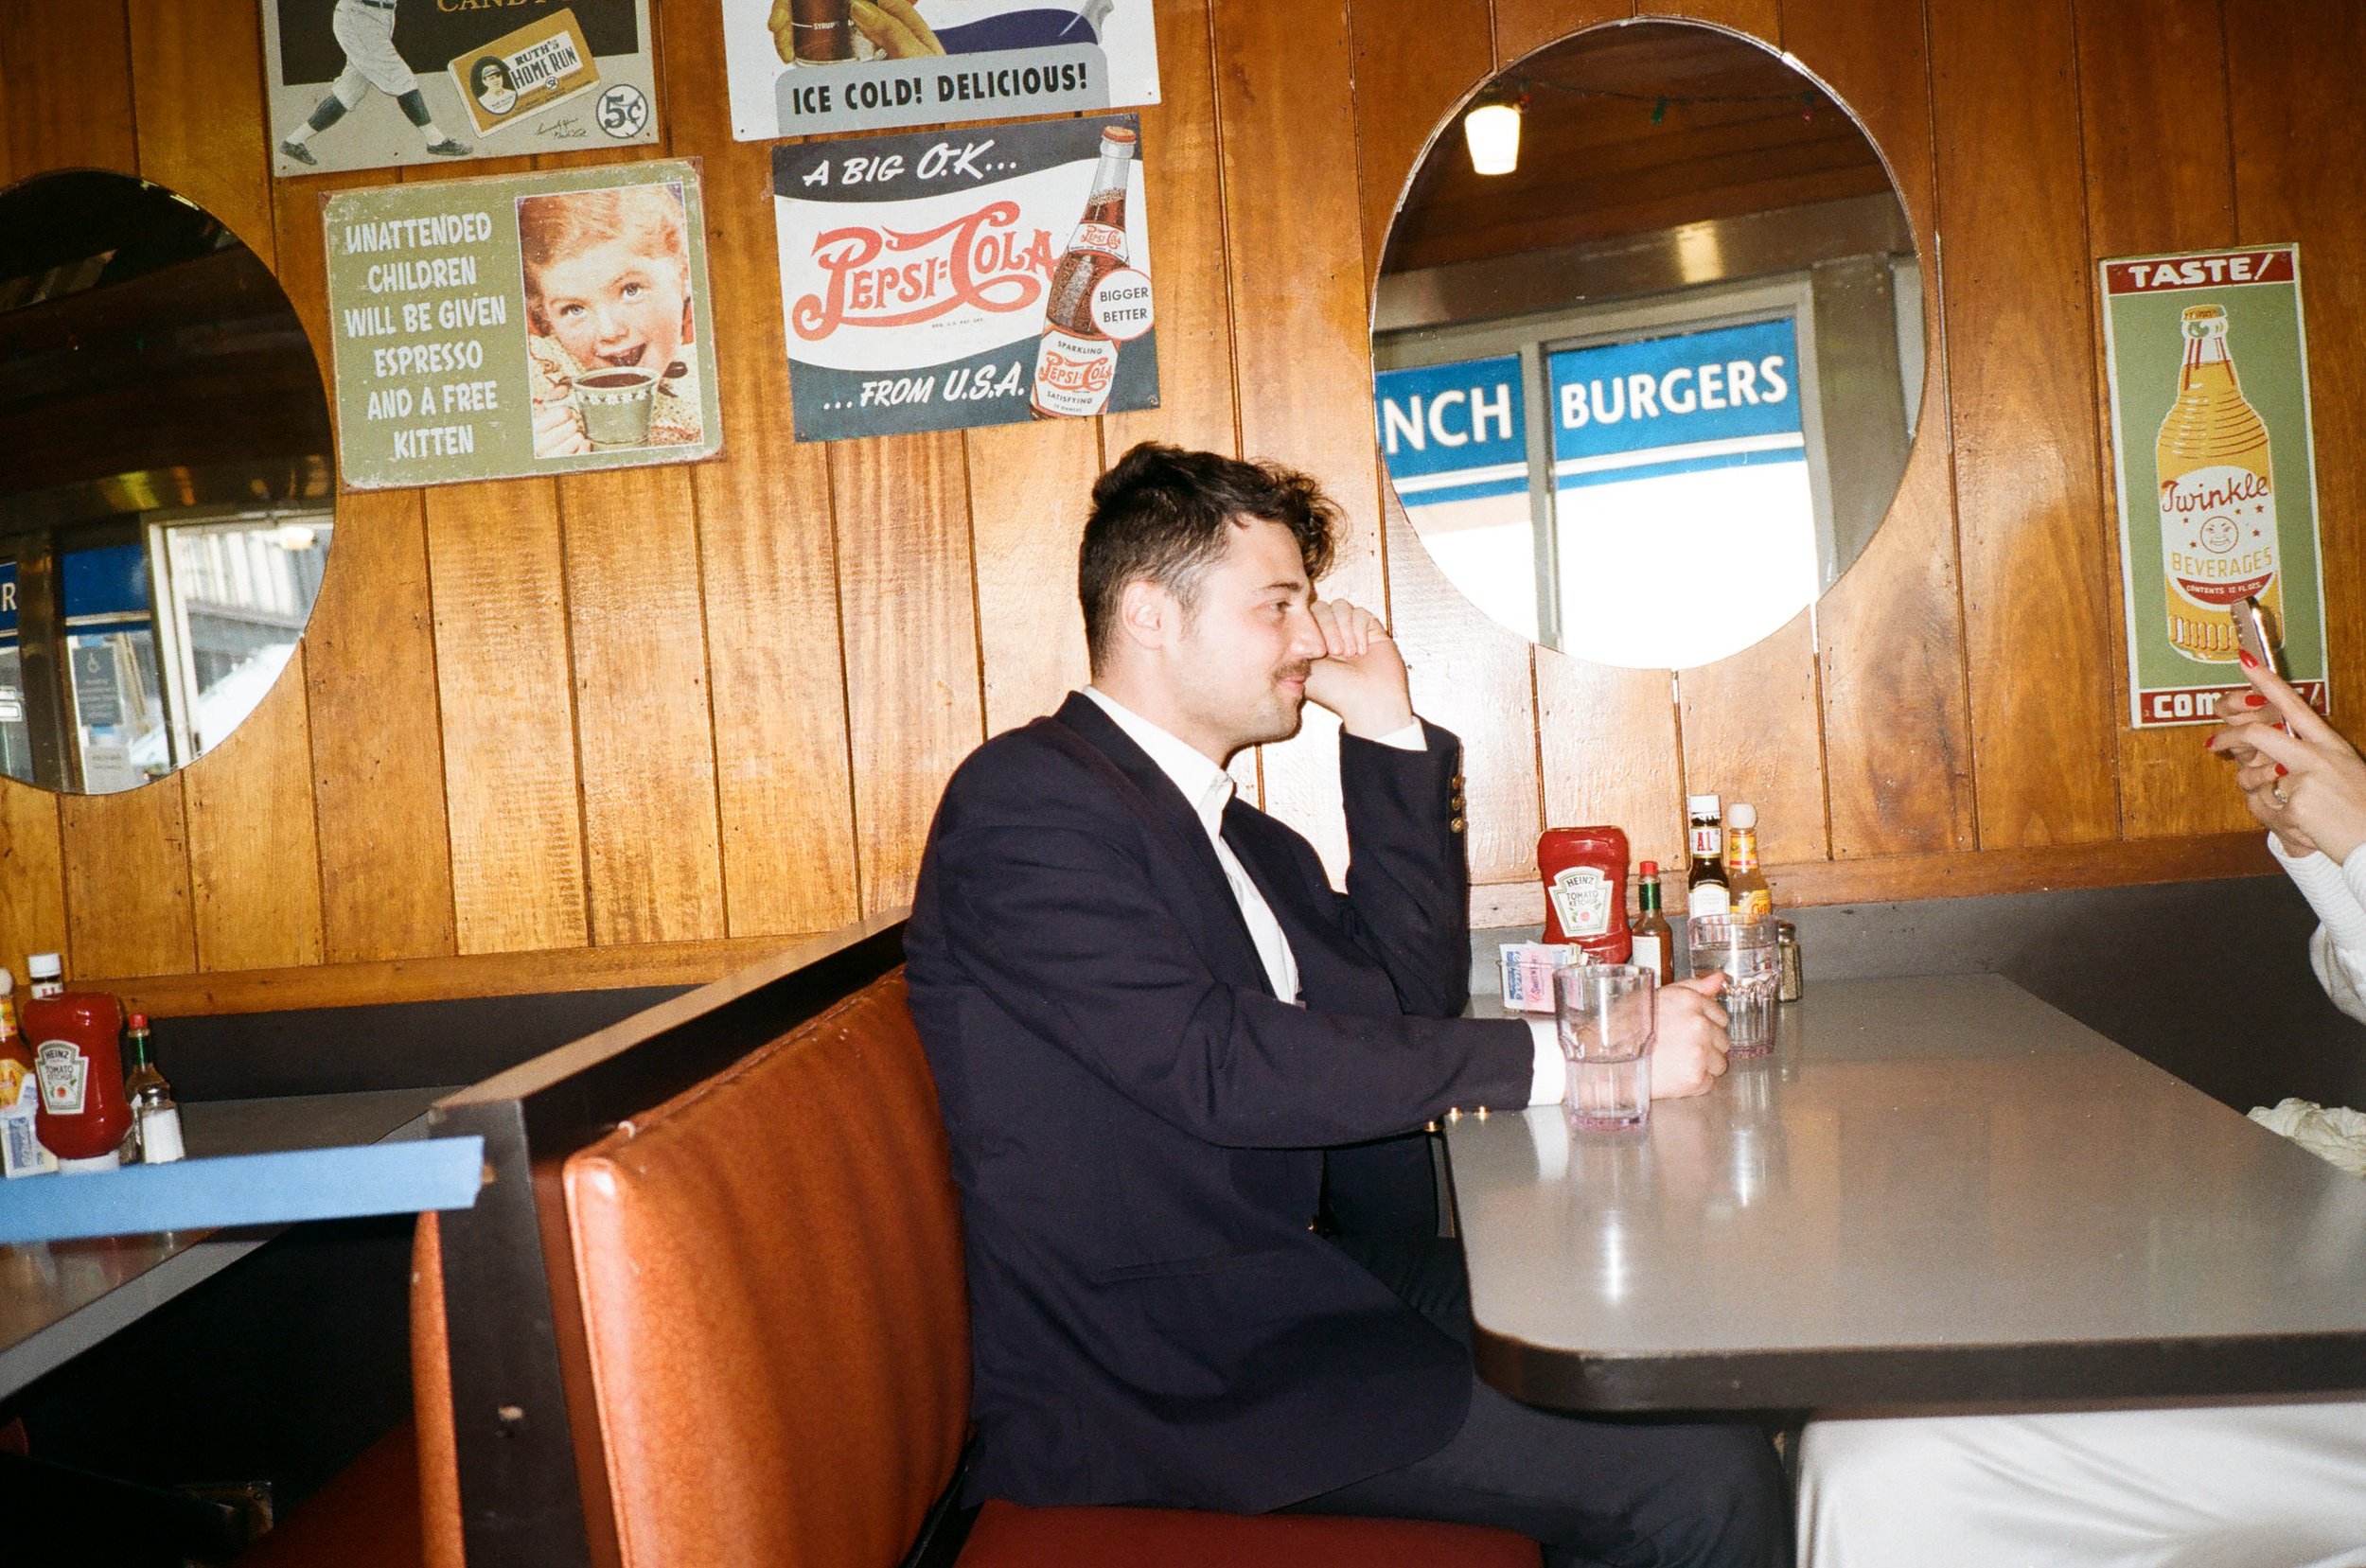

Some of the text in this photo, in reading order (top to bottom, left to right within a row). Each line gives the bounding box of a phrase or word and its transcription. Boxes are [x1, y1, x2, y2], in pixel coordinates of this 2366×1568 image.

[510, 59, 551, 89] HOME
[548, 46, 578, 74] RUN
[515, 39, 559, 64] RUTH'S
[792, 62, 1087, 115] ICE COLD! DELICIOUS!
[803, 159, 829, 186] A
[841, 155, 905, 185] BIG
[345, 211, 492, 255] UNATTENDED
[367, 256, 477, 294] CHILDREN
[2128, 253, 2274, 288] TASTE!
[1100, 287, 1149, 303] BIGGER
[344, 295, 506, 338] WILL BE GIVEN
[1104, 308, 1148, 323] BETTER
[374, 340, 484, 378] ESPRESSO
[1057, 341, 1104, 355] SPARKLING
[943, 361, 1026, 401] U.S.A.
[1047, 391, 1093, 404] SATISFYING
[1560, 354, 1789, 431] BURGERS
[367, 380, 498, 421] AND A FREE
[1382, 383, 1512, 455] NCH
[393, 425, 474, 460] KITTEN
[2161, 473, 2269, 512] Twinkle
[2171, 546, 2272, 578] BEVERAGES
[2186, 585, 2224, 594] CONTENTS
[1566, 876, 1595, 888] HEINZ
[1566, 890, 1598, 901] TOMATO
[45, 1049, 69, 1060] HEINZ
